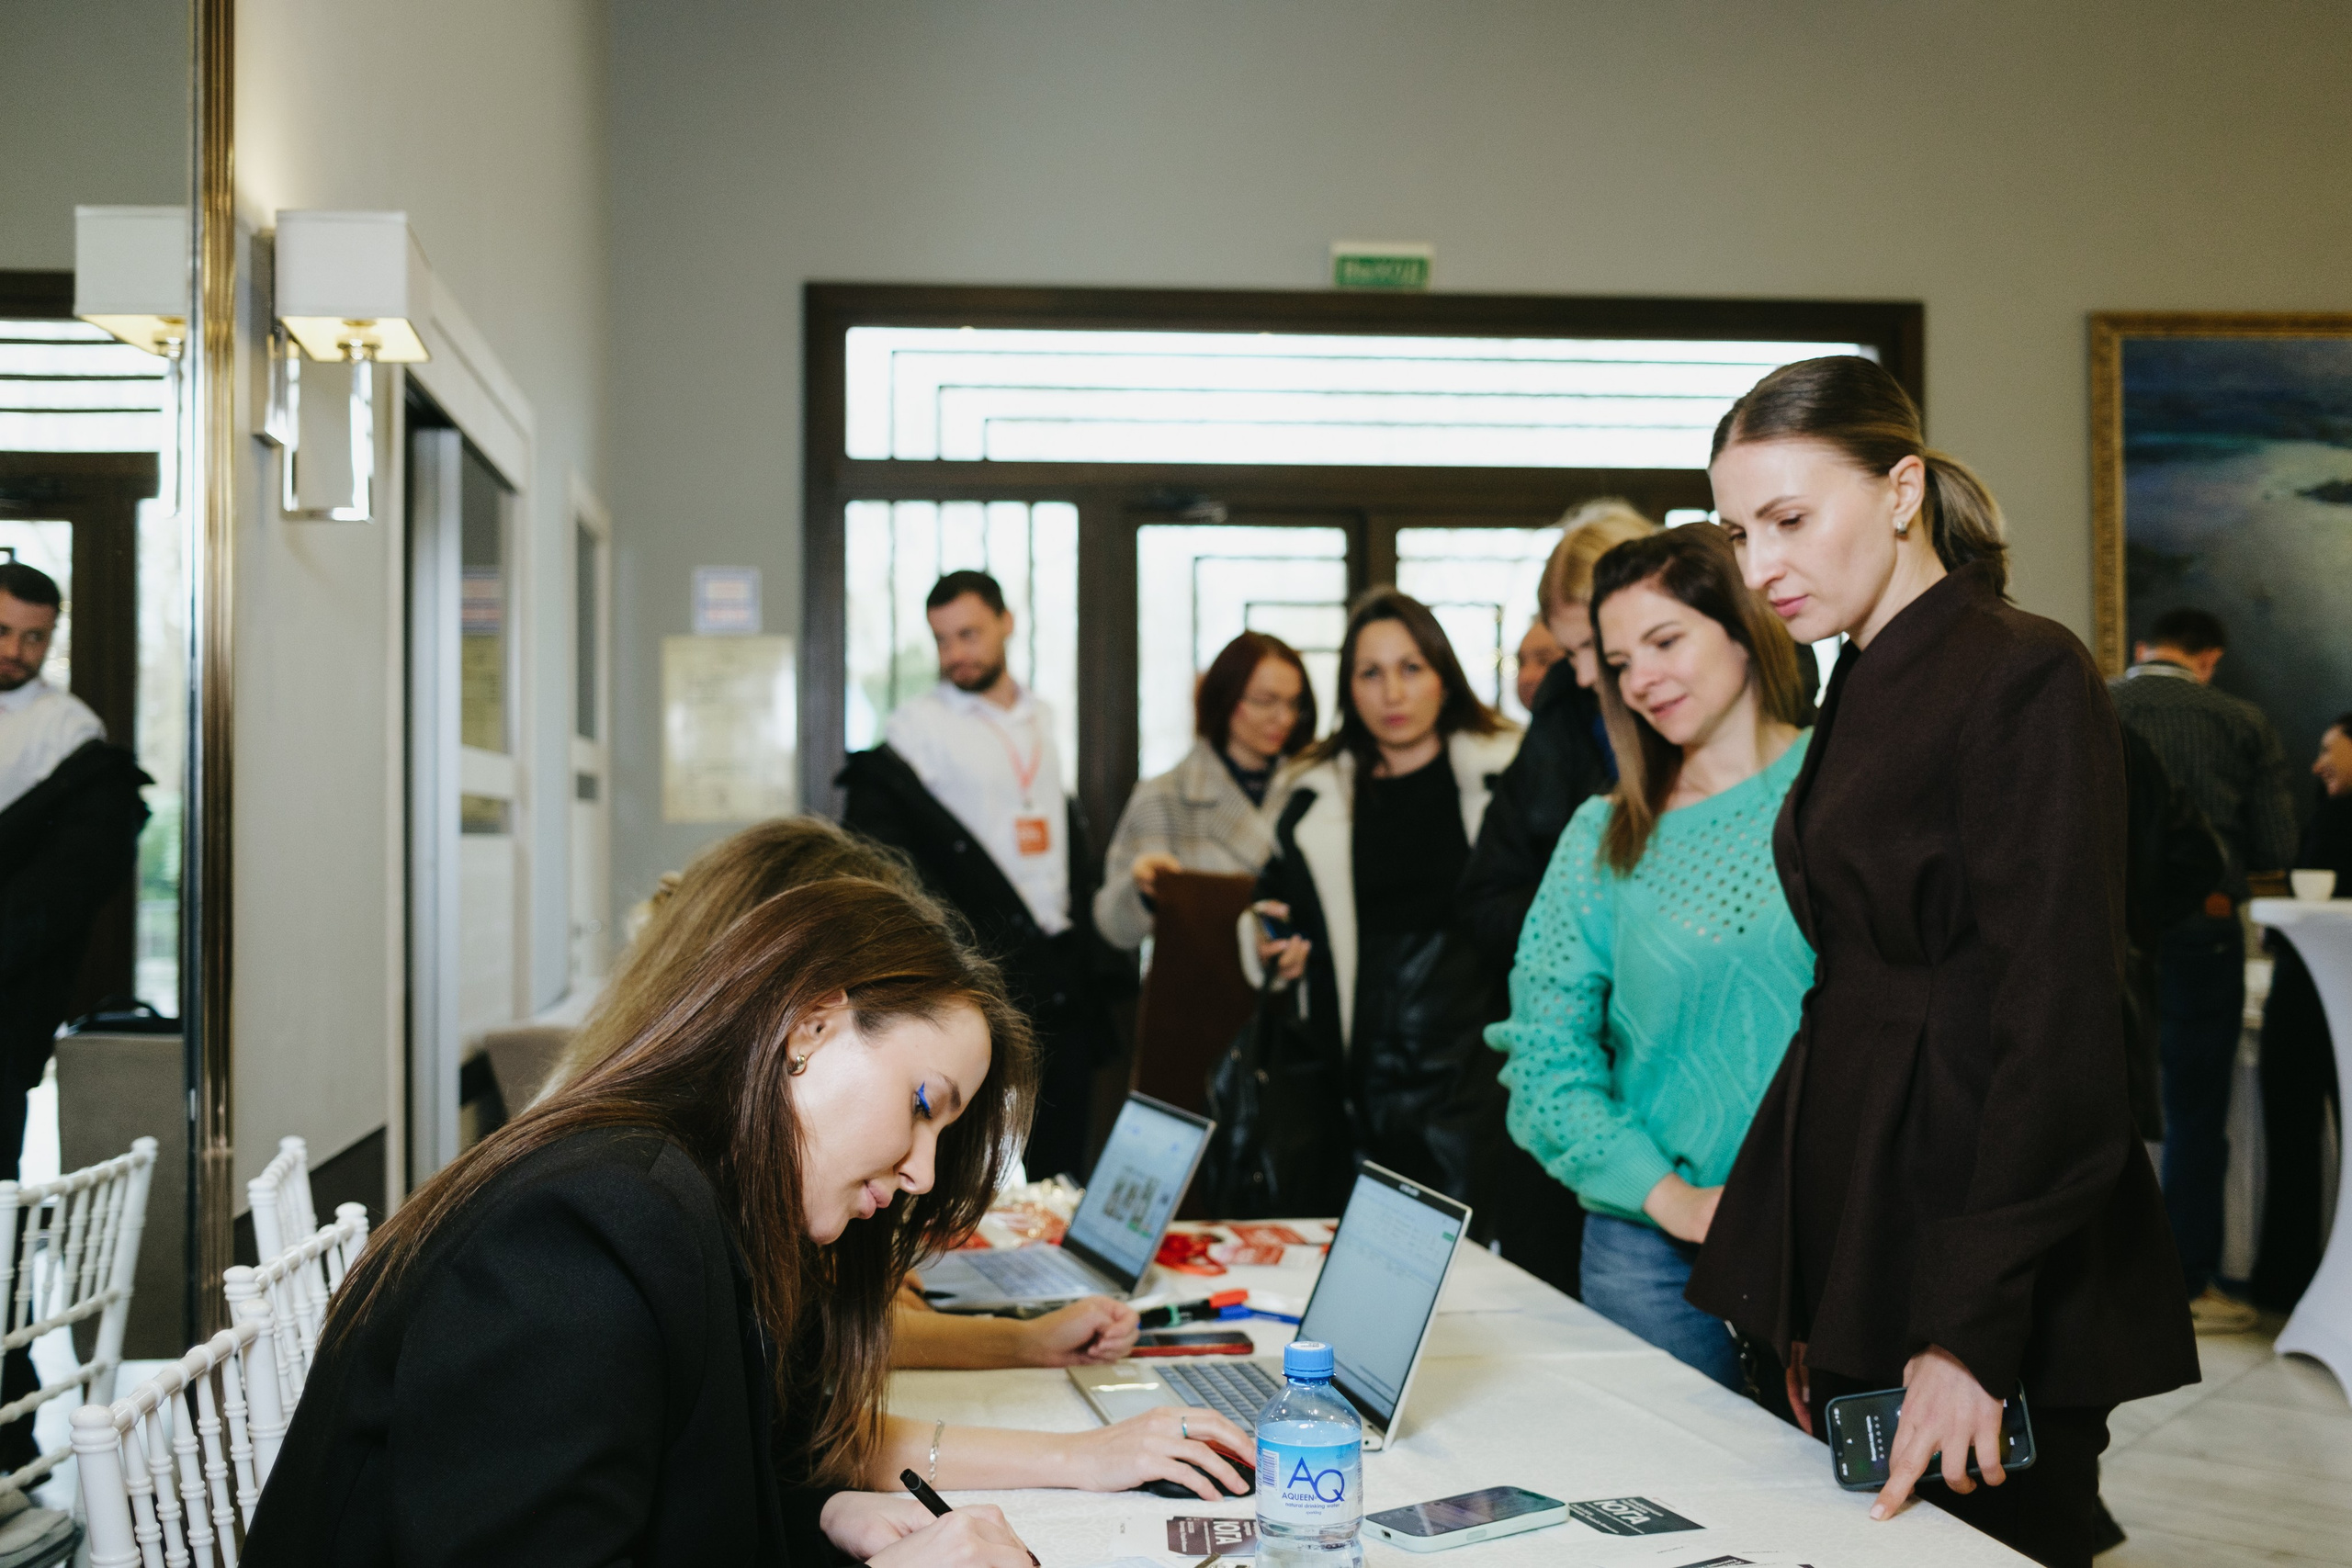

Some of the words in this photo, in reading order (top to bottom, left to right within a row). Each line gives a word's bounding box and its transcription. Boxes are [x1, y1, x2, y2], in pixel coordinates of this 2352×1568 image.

[1287, 1457, 1345, 1504] AQ
[1593, 1500, 1651, 1525] ЮГА
[1213, 1521, 1243, 1545] ЮГА
